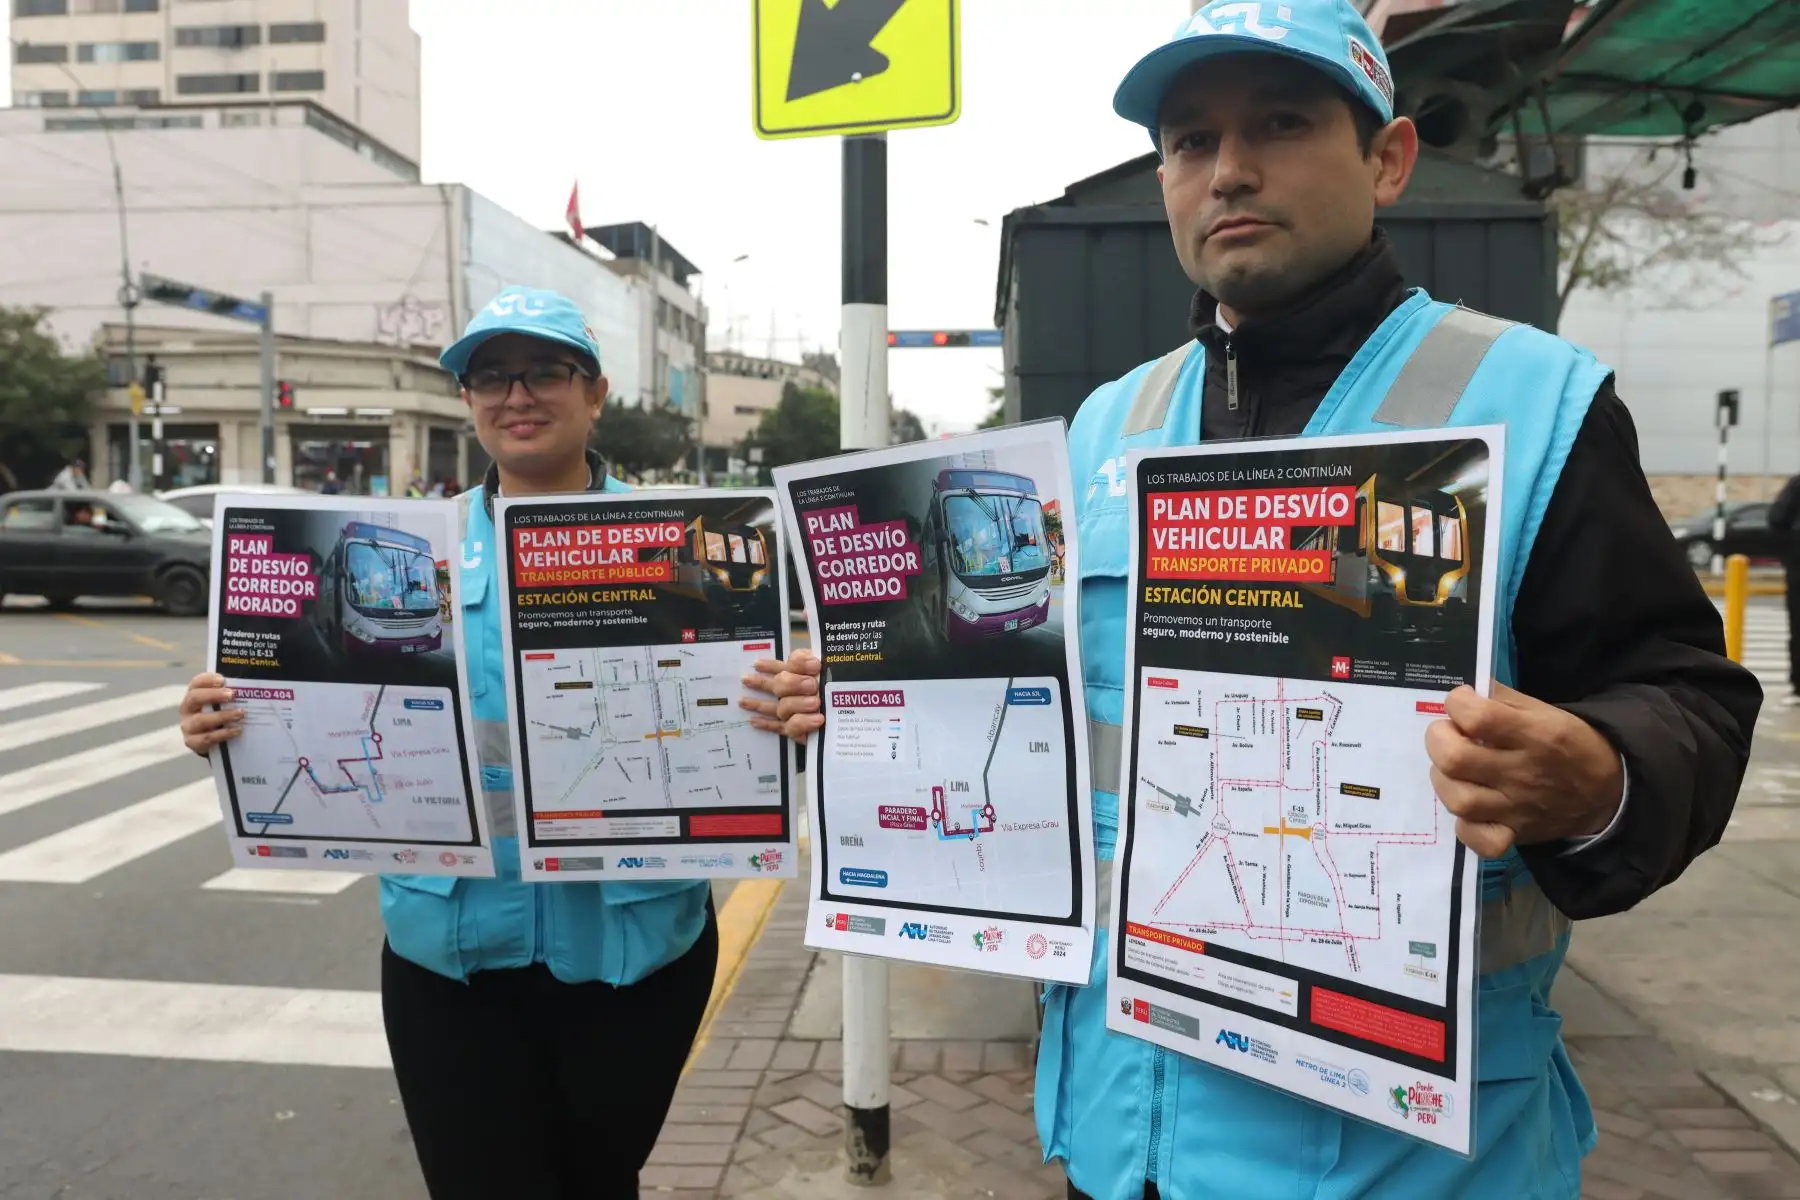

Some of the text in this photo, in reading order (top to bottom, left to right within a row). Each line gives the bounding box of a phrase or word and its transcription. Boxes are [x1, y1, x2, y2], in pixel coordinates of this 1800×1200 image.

[1147, 463, 1352, 485] LOS TRABAJOS DE LA LÍNEA 2 CONTINÚAN
[1153, 487, 1349, 521] PLAN DE DESVÍO
[514, 509, 685, 524] LOS TRABAJOS DE LA LÍNEA 2 CONTINÚAN
[808, 511, 854, 534] PLAN
[519, 522, 681, 548] PLAN DE DESVÍO
[813, 525, 906, 557] DE DESVÍO
[1152, 525, 1285, 550] VEHICULAR
[230, 539, 268, 556] PLAN
[229, 556, 309, 577] DE DESVÍO
[519, 548, 635, 568] VEHICULAR
[818, 551, 919, 579] CORREDOR
[1151, 556, 1324, 574] TRANSPORTE PRIVADO
[520, 565, 665, 583] TRANSPORTE PÚBLICO
[228, 576, 316, 597] CORREDOR
[823, 576, 902, 601] MORADO
[227, 595, 298, 615] MORADO
[517, 589, 657, 606] ESTACIÓN CENTRAL
[1144, 584, 1304, 609] ESTACIÓN CENTRAL
[518, 611, 574, 620] Promovemos
[589, 608, 633, 617] transporte
[1143, 611, 1272, 631] Promovemos un transporte
[519, 616, 648, 630] seguro, moderno y sostenible
[825, 619, 886, 632] Paraderos y rutas
[222, 638, 231, 646] de
[223, 629, 255, 639] Paraderos
[261, 632, 281, 641] rutas
[826, 633, 835, 642] de
[859, 632, 871, 642] por
[873, 630, 882, 639] las
[1142, 626, 1290, 645] seguro, moderno y sostenible
[256, 649, 274, 658] E-13
[826, 640, 878, 653] obras de la E-13
[826, 653, 855, 663] estacion
[1334, 661, 1347, 674] M
[233, 688, 292, 700] ERVICIO 404
[833, 692, 902, 706] SERVICIO 406
[986, 703, 1002, 743] Abancay
[1029, 741, 1050, 753] LIMA
[950, 780, 970, 793] LIMA
[884, 806, 918, 815] PARADERO
[1292, 805, 1304, 813] E-13
[906, 815, 924, 823] FINAL
[1013, 821, 1041, 831] Expresa
[1041, 820, 1060, 829] Grau
[617, 857, 644, 869] ATU
[842, 870, 886, 880] HACIA MAGDALENA
[898, 921, 928, 941] ATU
[1128, 925, 1203, 951] TRANSPORTE PRIVADO
[1215, 1028, 1249, 1053] ATU
[1295, 1058, 1318, 1071] METRO
[1318, 1065, 1329, 1075] DE
[1329, 1068, 1346, 1081] LIMA
[1417, 1112, 1437, 1125] PERÚ
